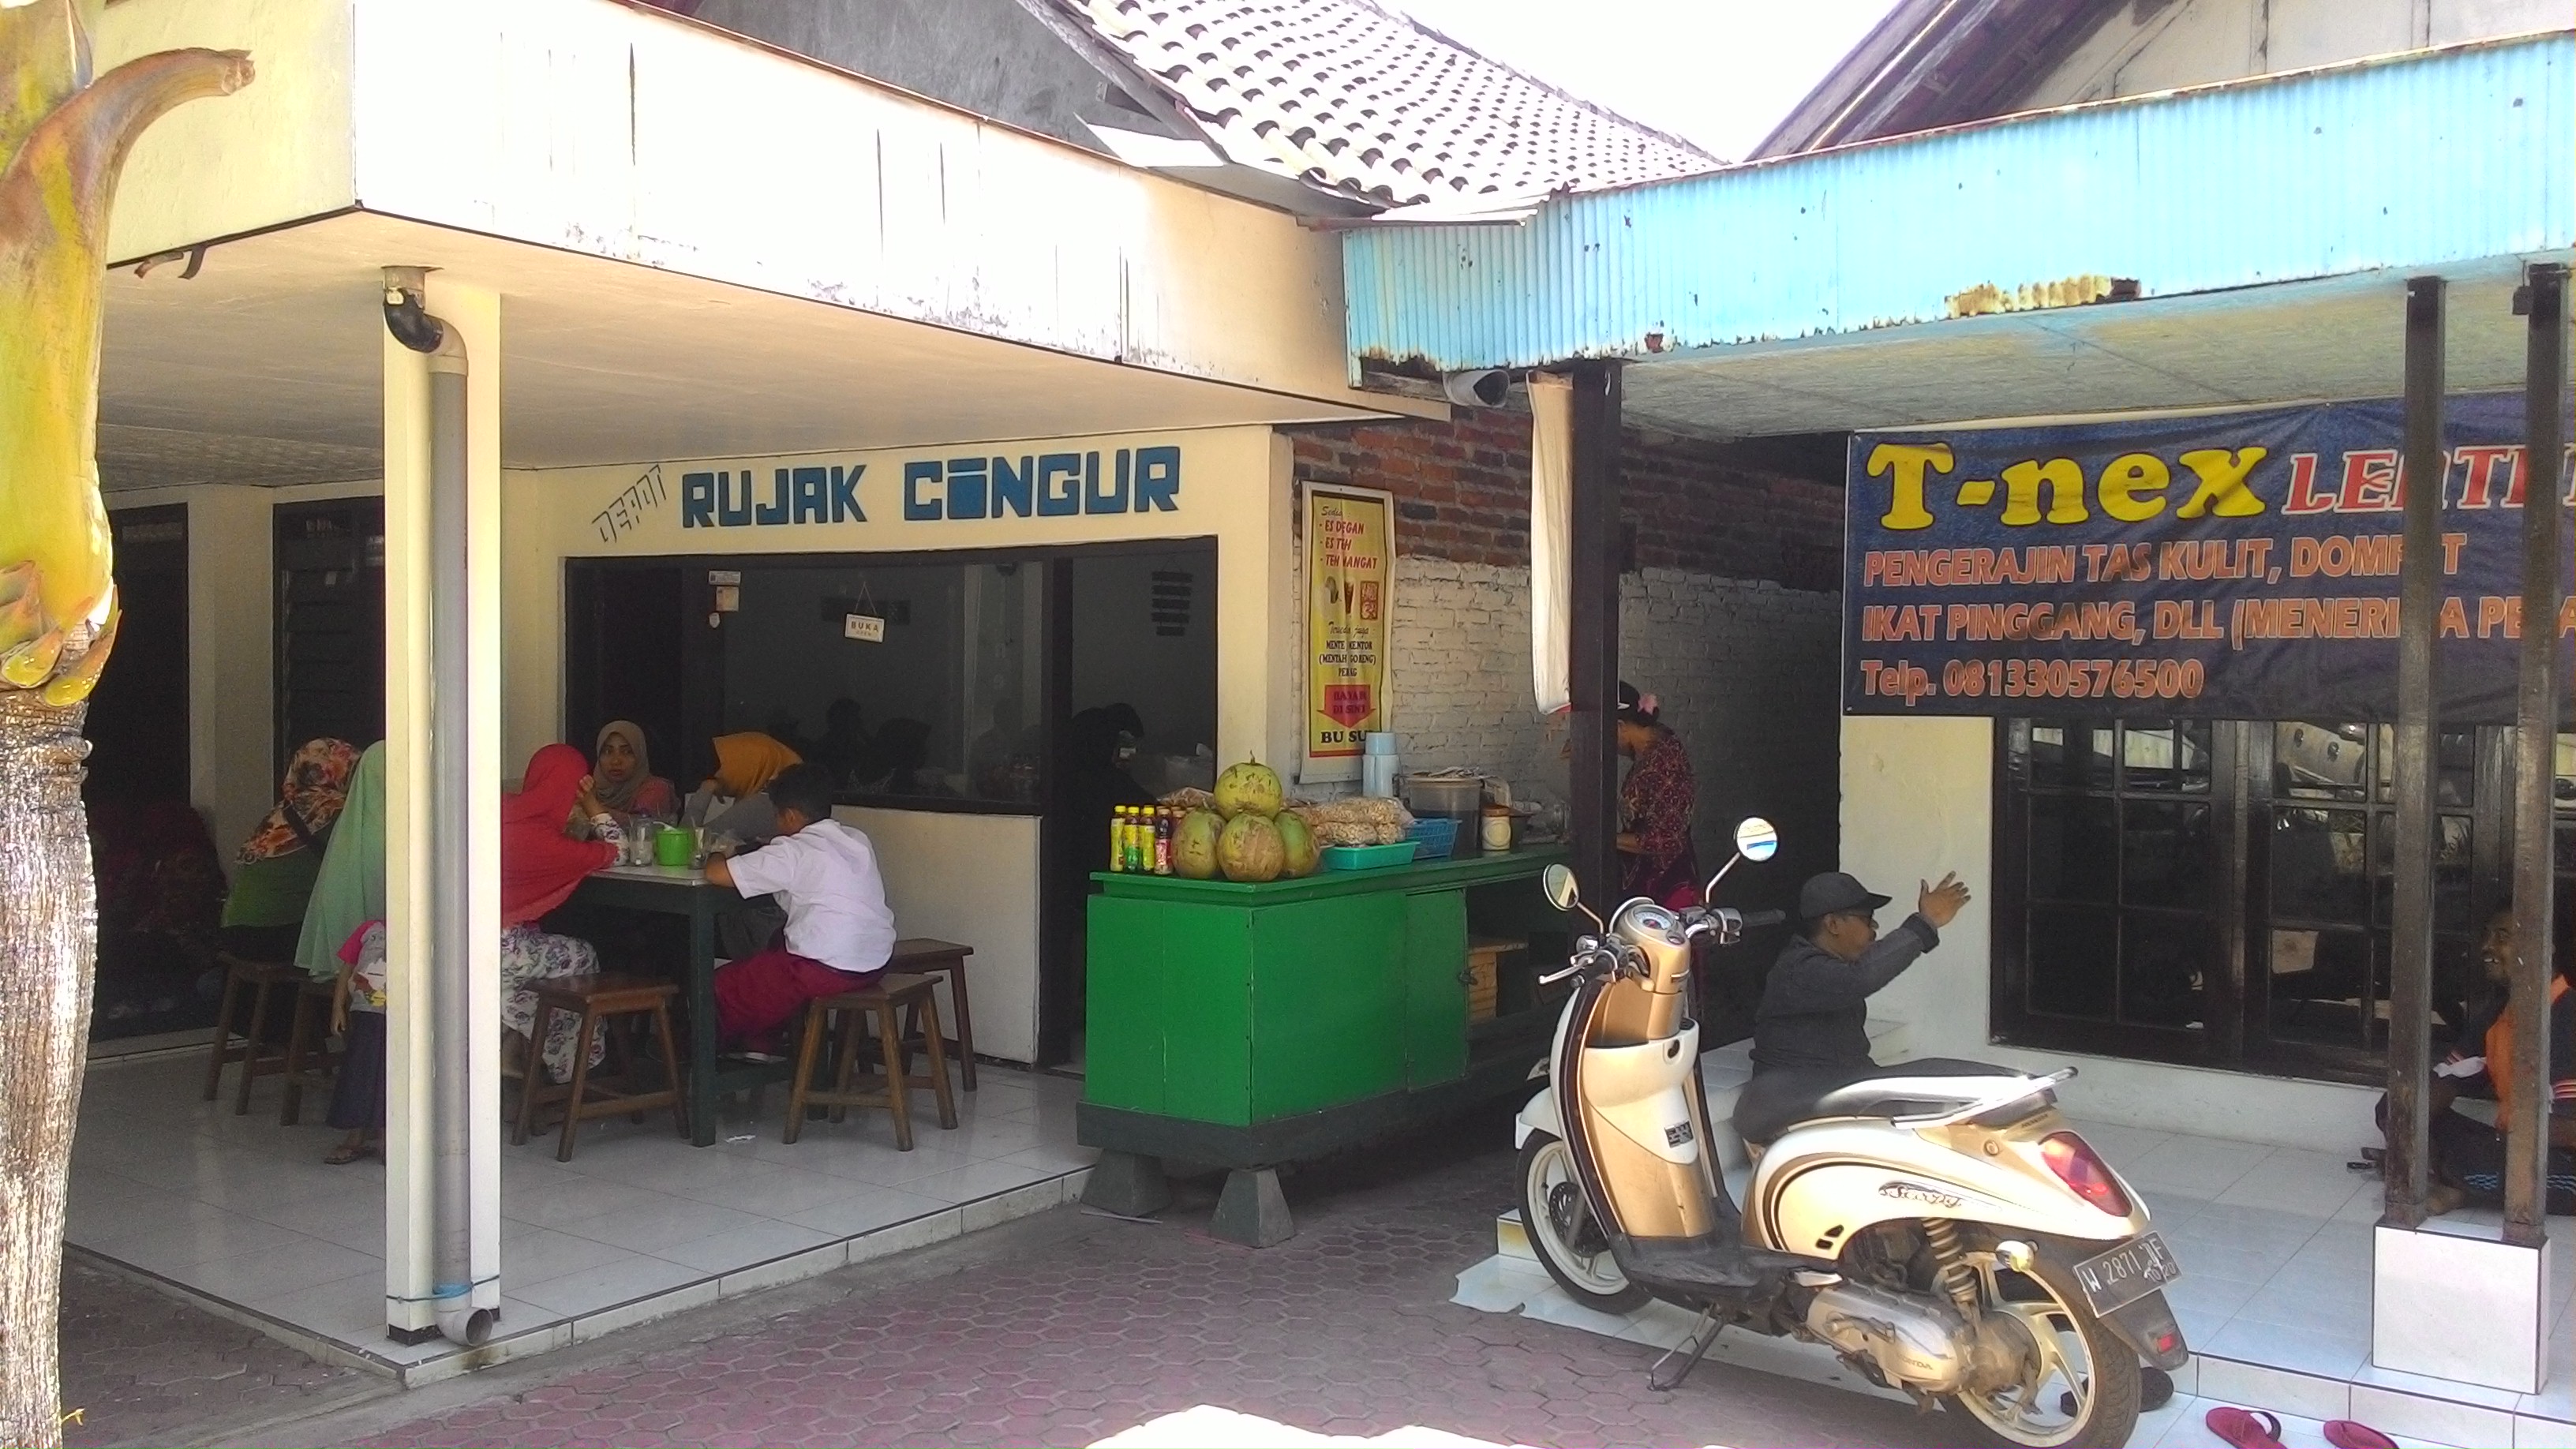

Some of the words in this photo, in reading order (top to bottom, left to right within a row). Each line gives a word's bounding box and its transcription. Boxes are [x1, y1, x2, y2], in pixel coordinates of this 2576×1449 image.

[681, 464, 868, 529] RUJAK
[1866, 442, 2268, 530] T-nex
[1325, 519, 1335, 532] ES
[1336, 520, 1365, 535] DEGAN
[1325, 537, 1335, 549] ES
[1326, 554, 1340, 567] TEH
[1863, 545, 2076, 587] PENGERAJIN
[2082, 543, 2152, 583] TAS
[2159, 538, 2282, 585] KULIT,
[2290, 532, 2468, 578] DOMPT
[850, 621, 879, 632] BUKA
[1861, 604, 1942, 642] IKAT
[2152, 600, 2225, 640] DLL
[2231, 596, 2471, 651] (MENERIA
[1860, 659, 1937, 706] Telp.
[1942, 658, 2205, 698] 081330576500
[1320, 731, 1344, 743] BU
[1348, 729, 1373, 743] SU
[2082, 1267, 2102, 1294] W
[2102, 1249, 2143, 1286] 2871
